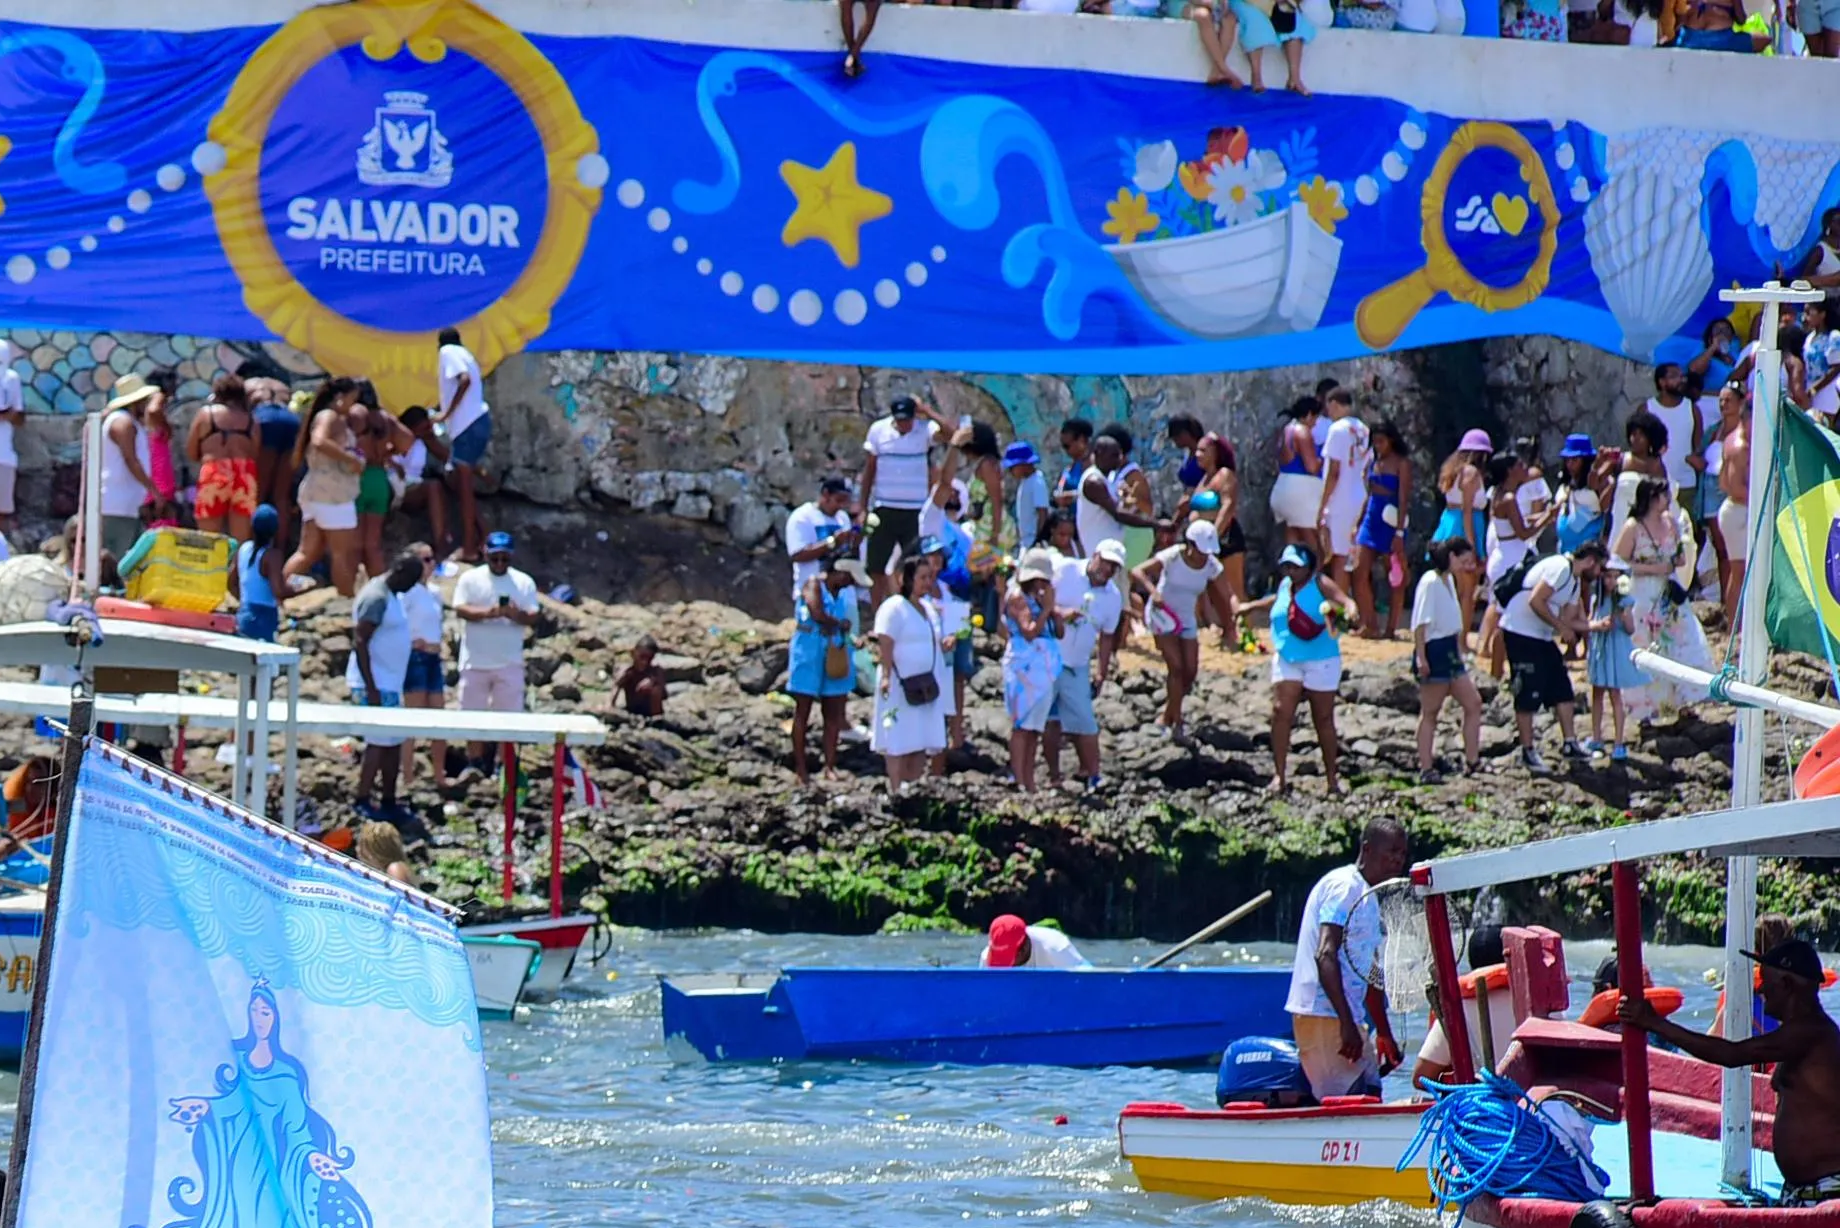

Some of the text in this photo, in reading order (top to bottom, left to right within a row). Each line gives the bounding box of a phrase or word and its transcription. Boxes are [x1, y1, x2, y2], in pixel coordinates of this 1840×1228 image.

[286, 197, 521, 248] SALVADOR
[319, 247, 486, 276] PREFEITURA
[1243, 1051, 1273, 1063] YAMAHA
